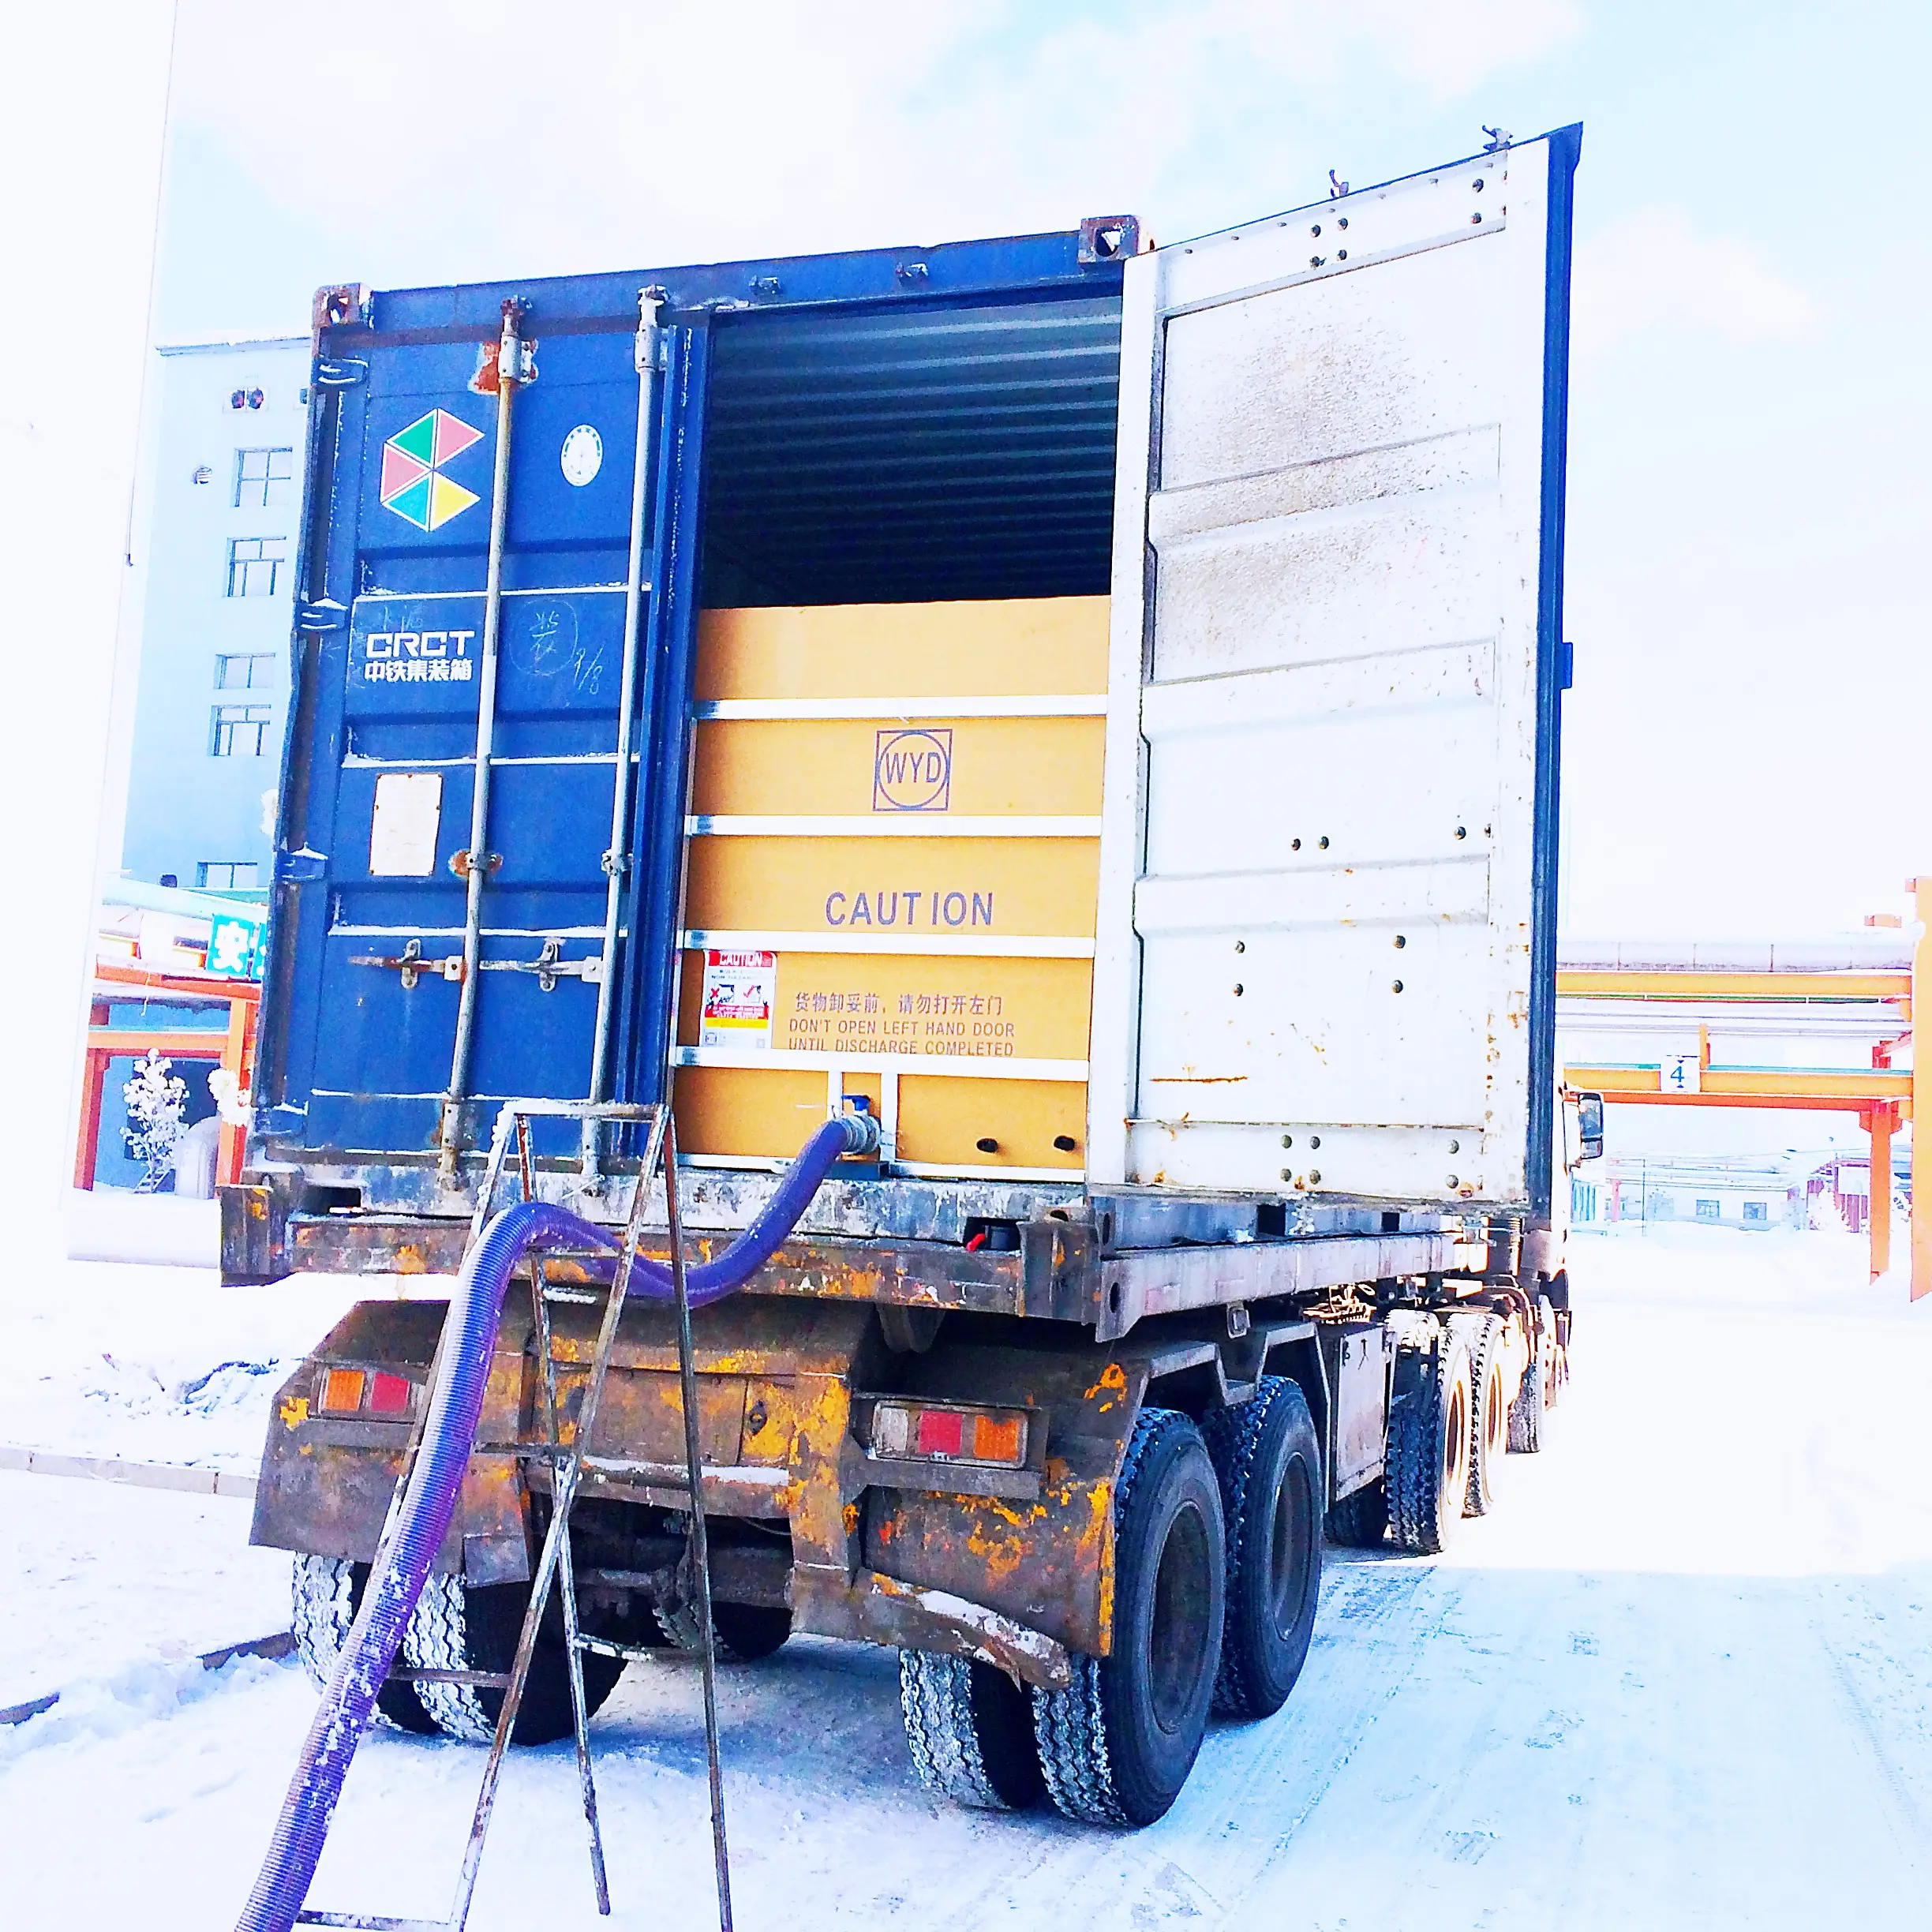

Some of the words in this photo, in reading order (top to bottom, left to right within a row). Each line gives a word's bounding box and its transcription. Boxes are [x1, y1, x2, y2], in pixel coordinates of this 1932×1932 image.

[366, 631, 475, 658] CRCT
[364, 658, 474, 683] 中铁集装箱
[886, 751, 942, 784] WYD
[826, 891, 993, 926] CAUTION
[720, 953, 762, 967] CAUTION
[789, 1018, 831, 1032] DON'T
[838, 1020, 876, 1035] OPEN
[883, 1021, 919, 1035] LEFT
[926, 1022, 965, 1036] HAND
[973, 1023, 1015, 1038] DOOR
[789, 1037, 828, 1051] UNTIL
[836, 1039, 918, 1054] DISCHARGE
[925, 1041, 1013, 1057] COMPLETED
[1670, 1065, 1685, 1082] 4
